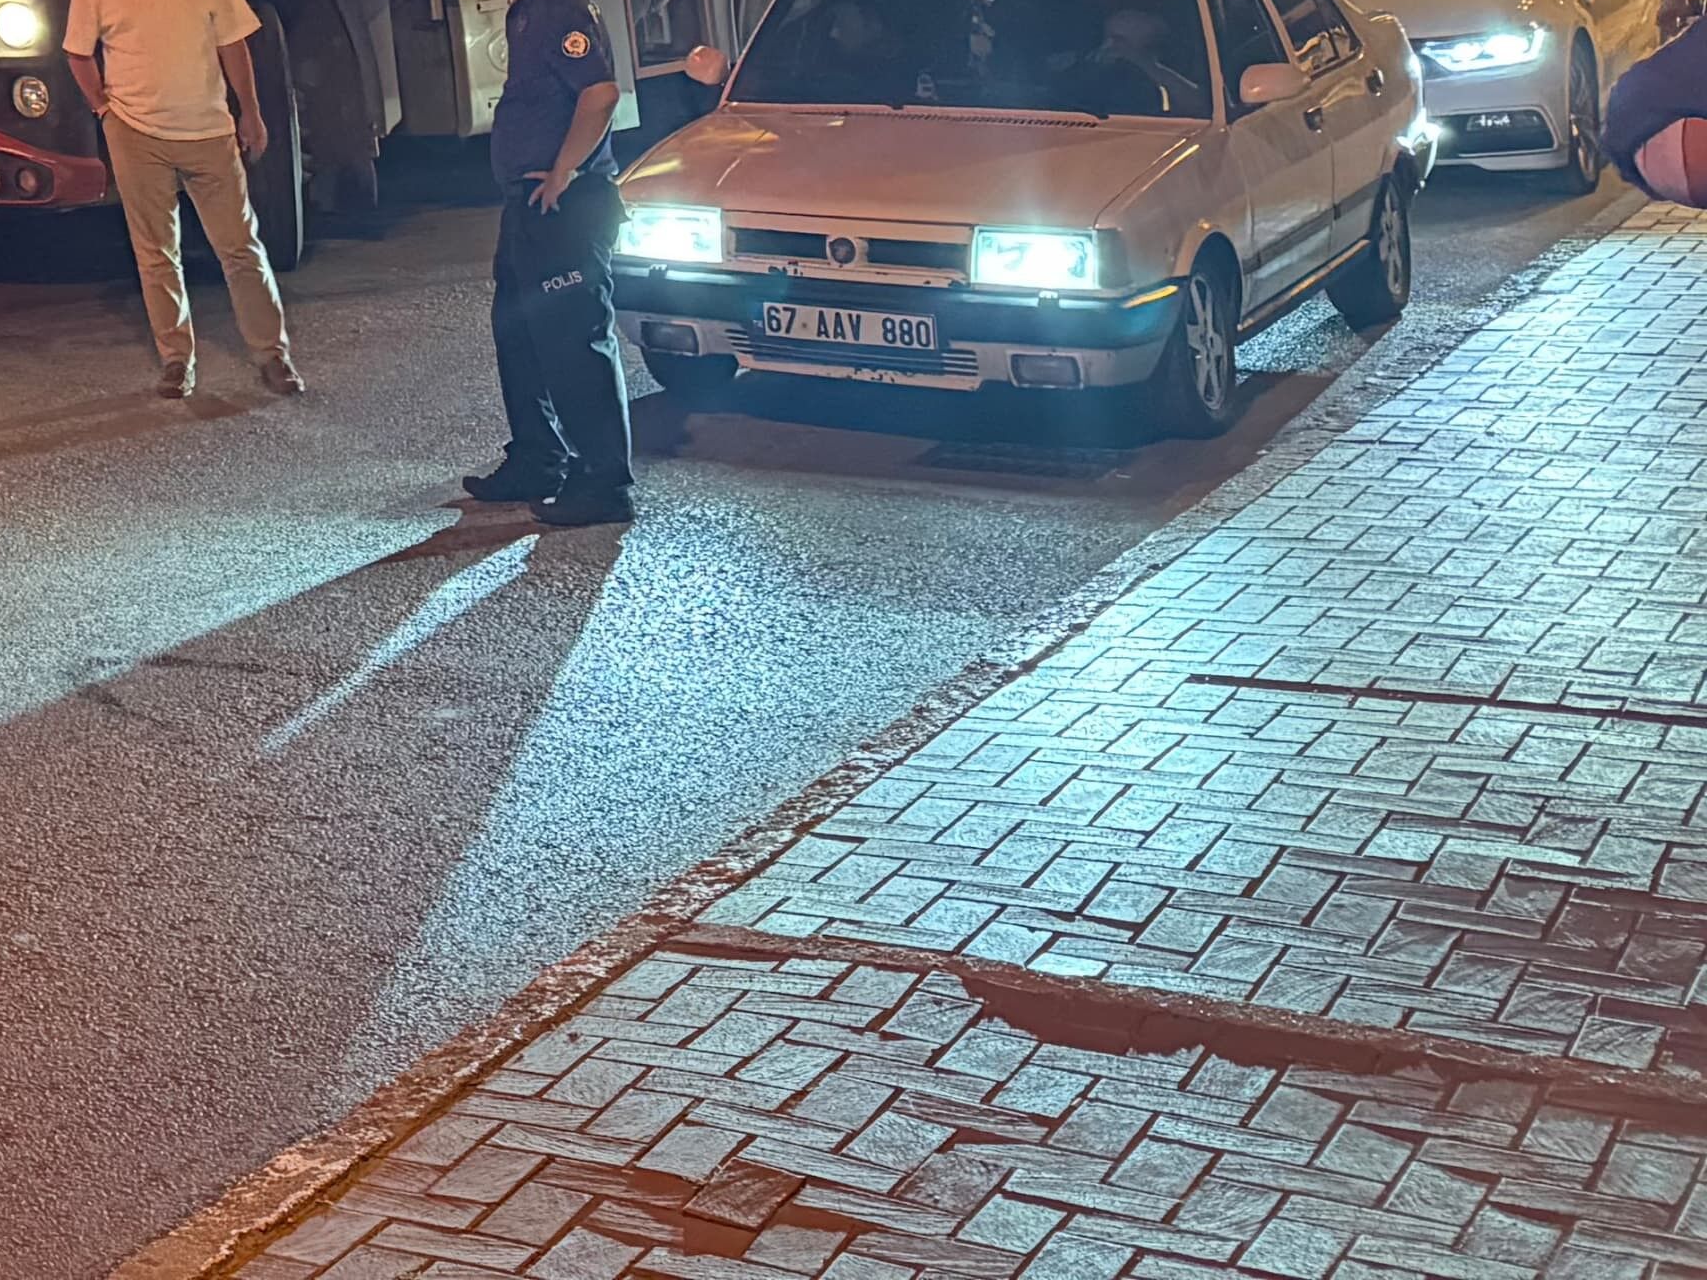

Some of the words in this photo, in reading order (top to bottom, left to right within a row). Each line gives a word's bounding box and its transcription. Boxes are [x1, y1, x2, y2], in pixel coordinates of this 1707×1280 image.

[766, 306, 796, 334] 67
[816, 310, 861, 342] AAV
[882, 317, 931, 348] 880
